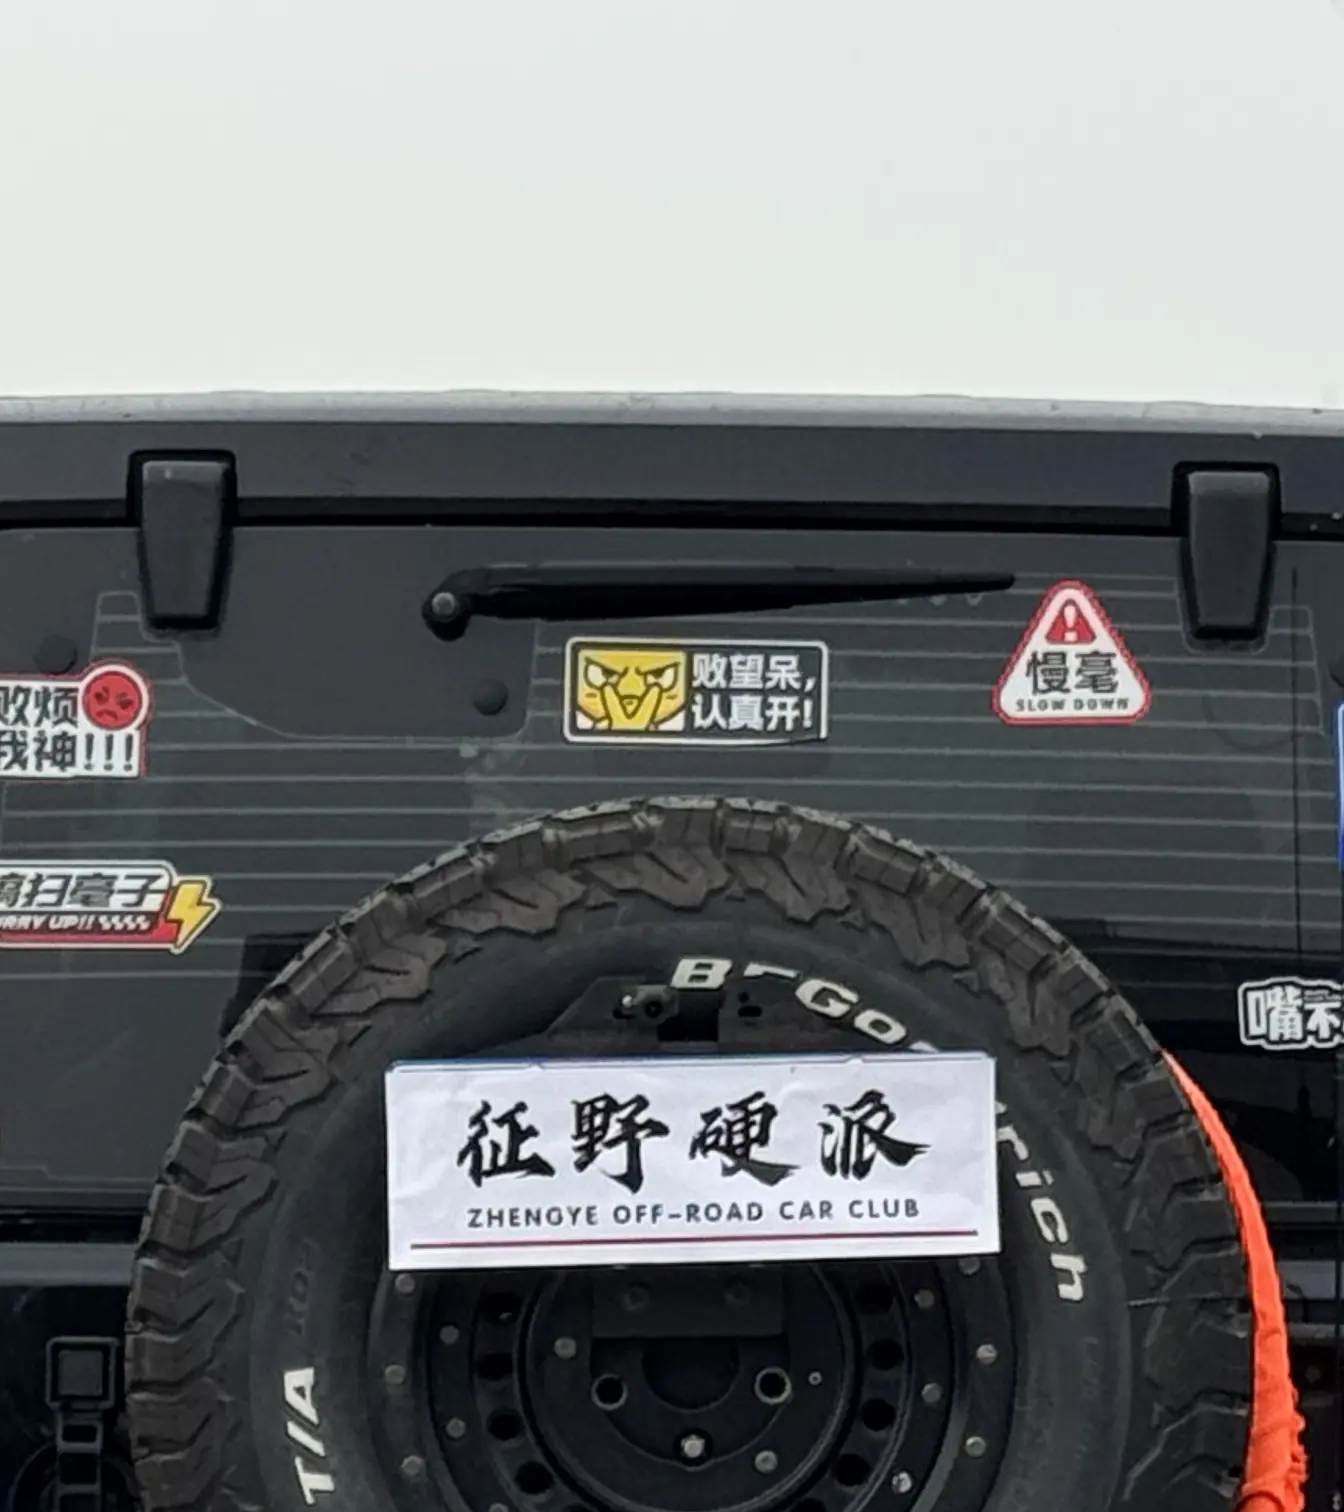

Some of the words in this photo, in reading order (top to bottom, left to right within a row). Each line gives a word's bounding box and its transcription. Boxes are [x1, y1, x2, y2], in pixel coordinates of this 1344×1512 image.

[1025, 650, 1119, 696] 慢毫
[1016, 698, 1066, 712] SLOW
[1073, 697, 1129, 711] DOWN
[456, 1088, 932, 1193] 征野硬派
[467, 1205, 599, 1229] ZHENGYE
[612, 1201, 764, 1226] OFF-ROAD
[778, 1200, 834, 1222] CAR
[848, 1198, 921, 1219] CLUB
[283, 1366, 336, 1505] T/A
